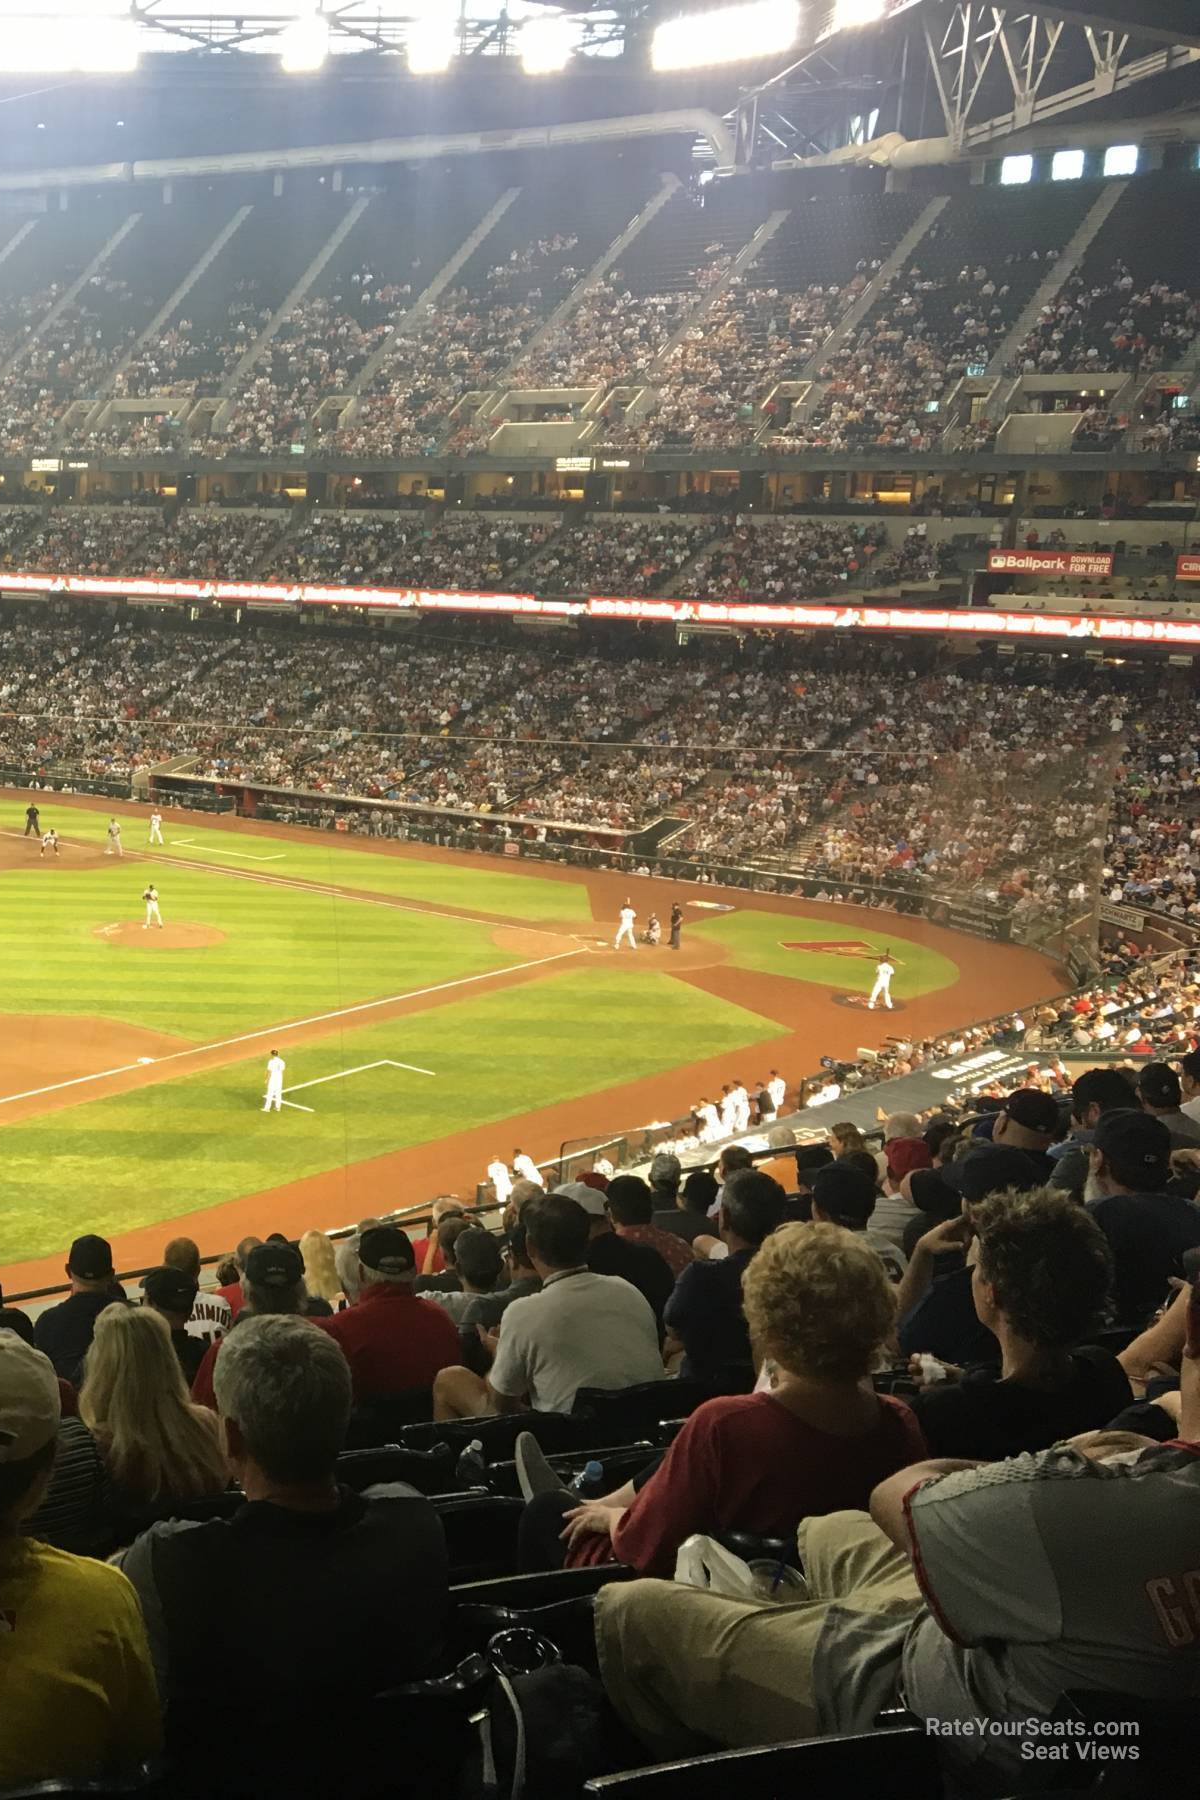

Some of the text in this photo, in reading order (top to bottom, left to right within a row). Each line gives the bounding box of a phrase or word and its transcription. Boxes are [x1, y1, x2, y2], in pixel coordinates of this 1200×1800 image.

[1006, 555, 1066, 571] Ballpark
[1070, 555, 1111, 564] DOWNLOAD
[1069, 564, 1110, 574] FOR FREE
